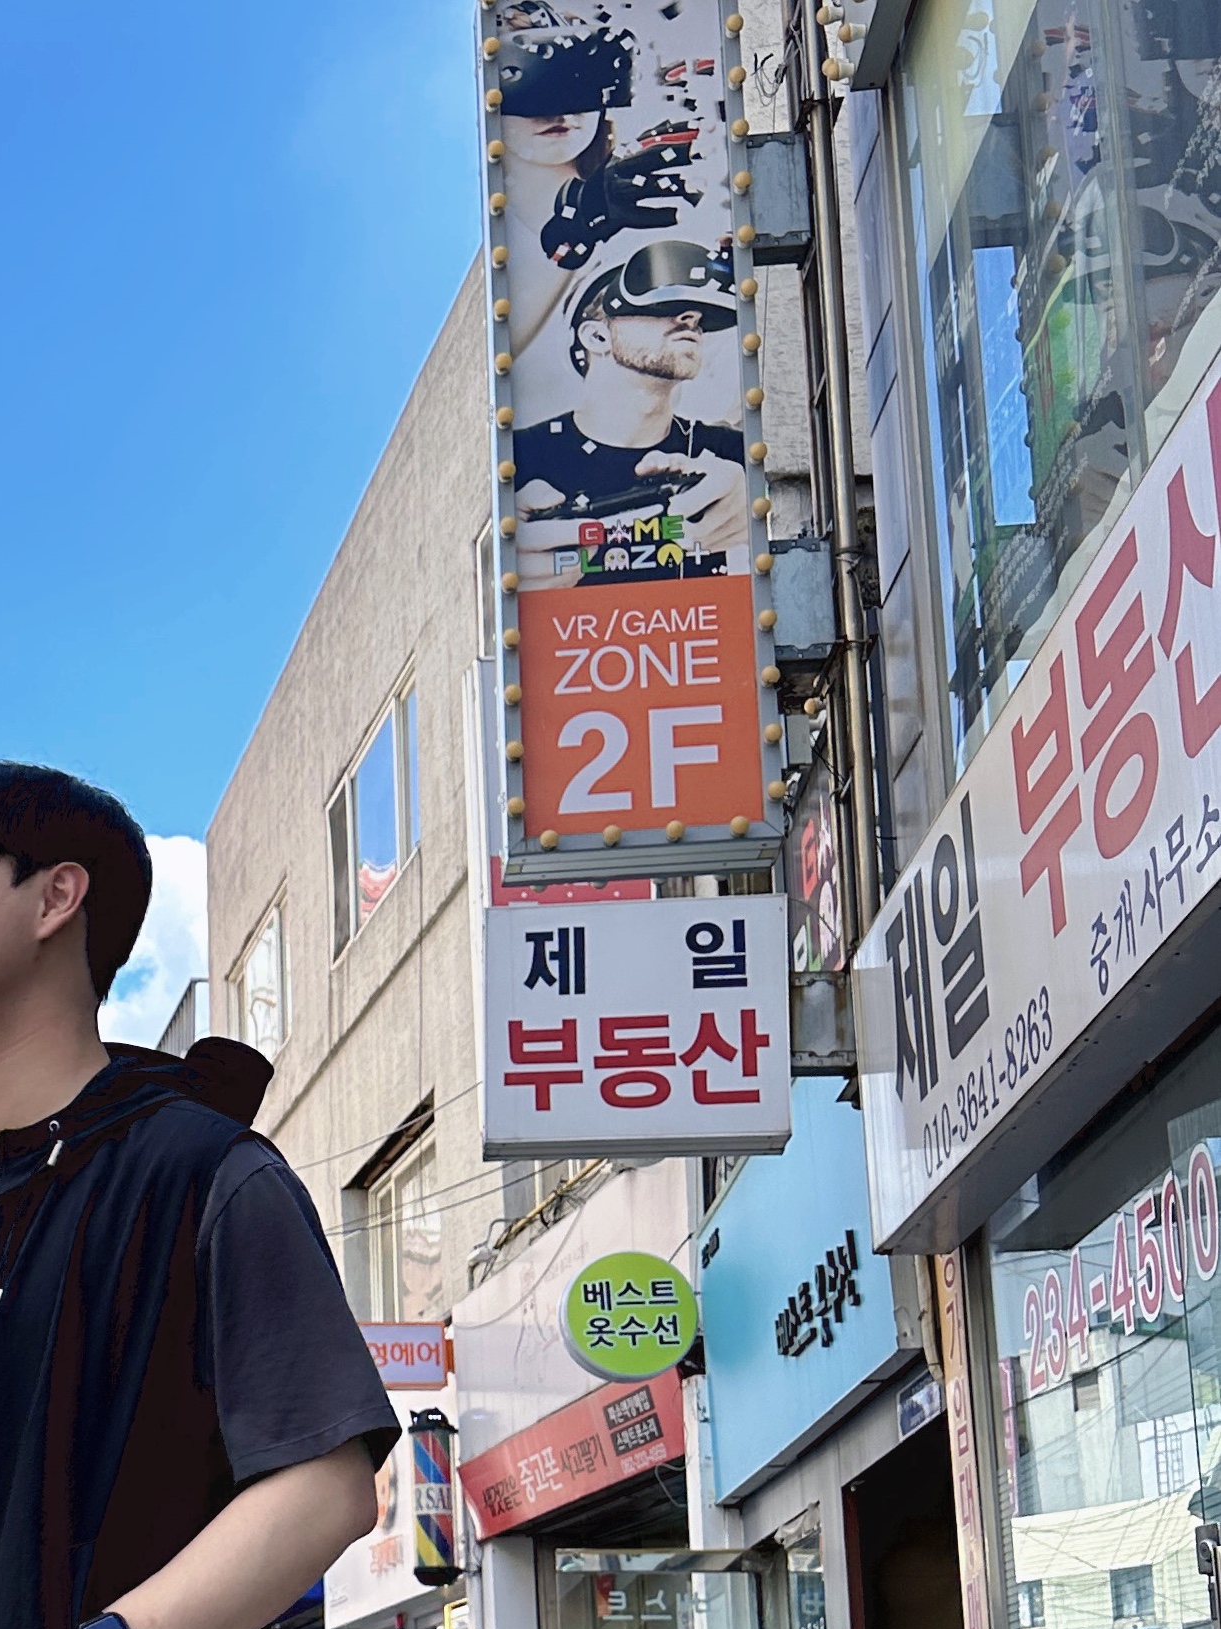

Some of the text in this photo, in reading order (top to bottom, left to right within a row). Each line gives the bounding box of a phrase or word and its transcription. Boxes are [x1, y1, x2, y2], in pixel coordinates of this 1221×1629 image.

[553, 605, 718, 641] VR/GAME
[554, 639, 721, 695] ZONE
[558, 704, 723, 815] 2F
[1090, 794, 1221, 996] 중개사무소
[885, 791, 991, 1103] 제일
[504, 1009, 769, 1110] 부동산
[923, 985, 1053, 1178] 010-3641-8263
[583, 1280, 679, 1312] 베스트
[1023, 1143, 1219, 1397] 234-4500
[585, 1315, 681, 1348] 옷수선
[517, 1446, 562, 1503] 중고폰
[559, 1432, 608, 1481] 사고팔기
